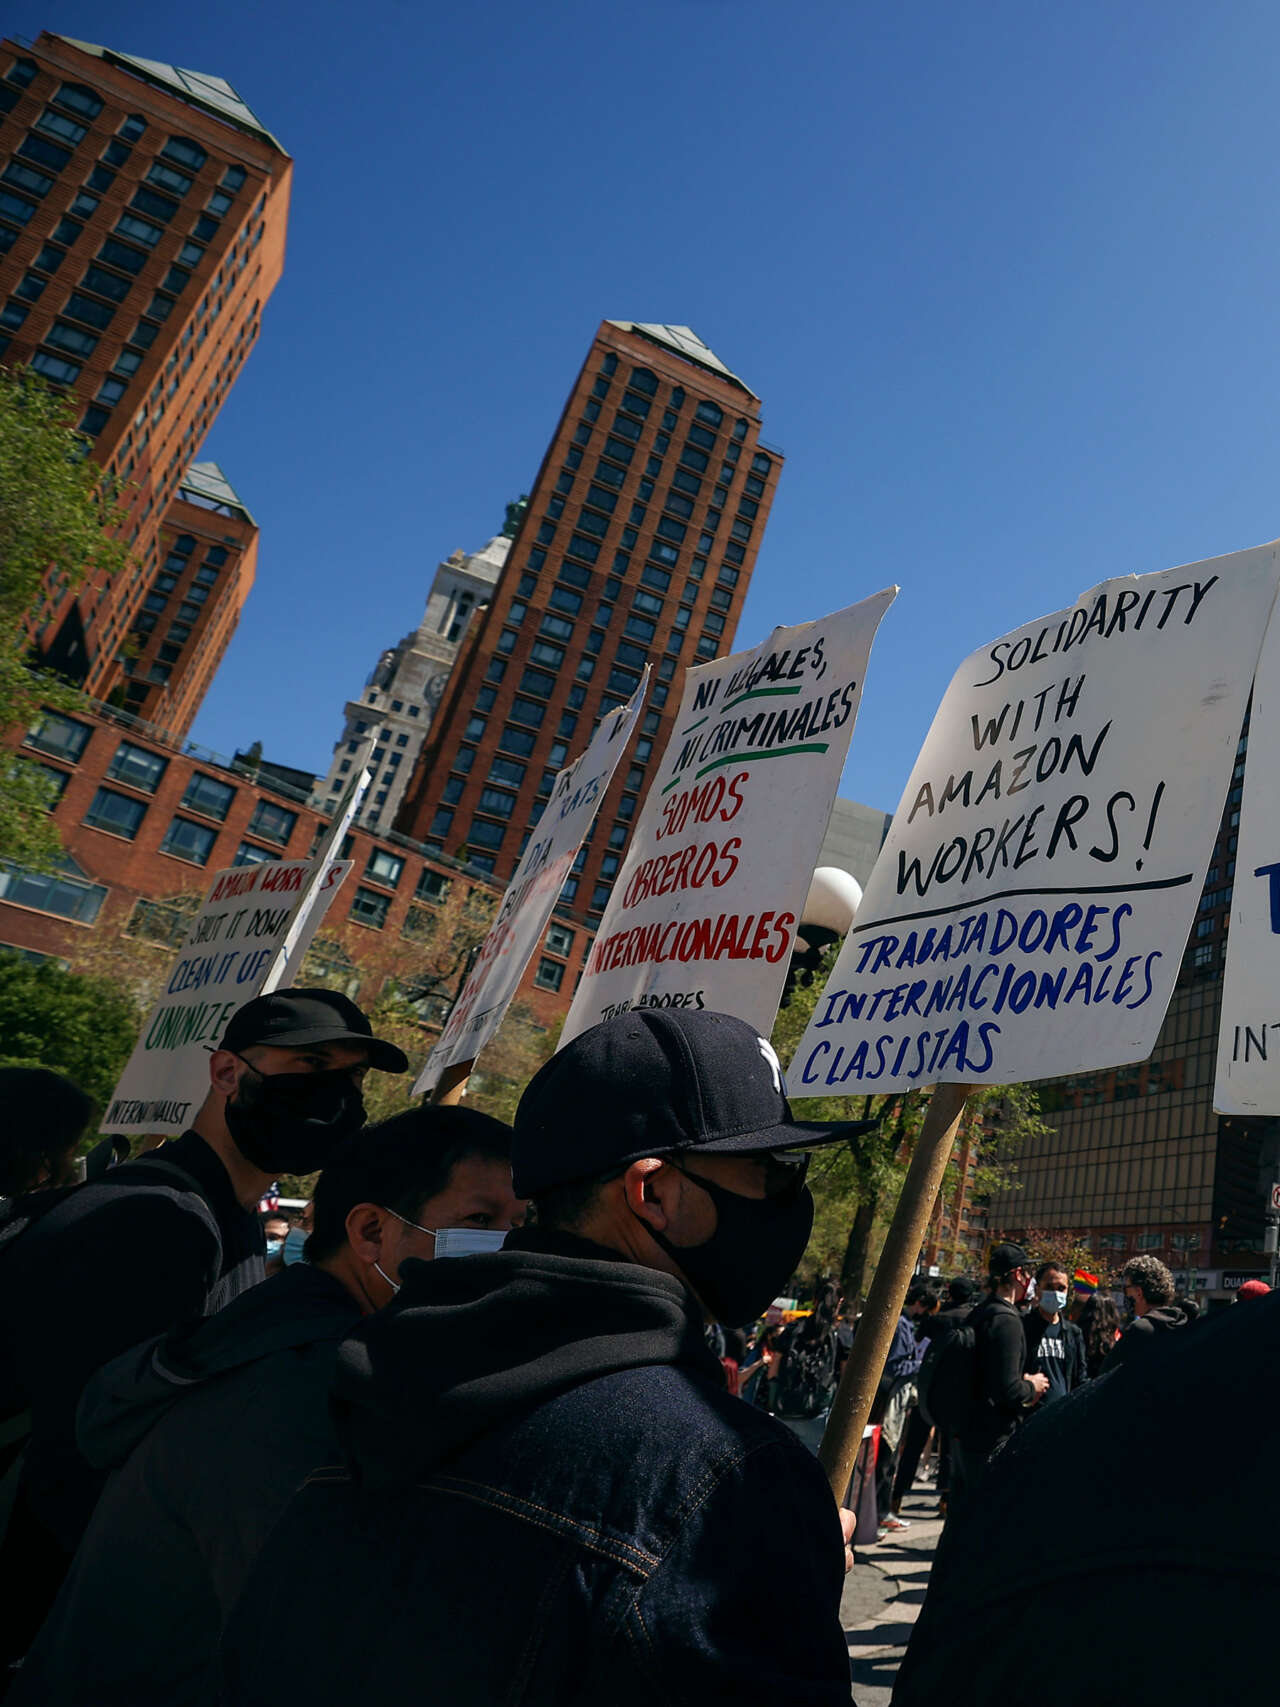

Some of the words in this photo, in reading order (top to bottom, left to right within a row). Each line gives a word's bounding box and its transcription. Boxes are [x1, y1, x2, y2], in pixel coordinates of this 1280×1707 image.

[973, 575, 1220, 688] SOLIDARITY
[692, 678, 717, 712] NI
[724, 637, 827, 699] ILLEGALES,
[672, 732, 698, 774] NI
[698, 681, 857, 763] CRIMINALES
[971, 673, 1086, 751] WITH
[655, 772, 749, 841] SOMOS
[907, 719, 1113, 824] AMAZON
[622, 836, 742, 910] OBREROS
[896, 781, 1165, 897] WORKERS!
[225, 908, 249, 940] IT
[585, 911, 796, 977] INTERNACIONALES
[856, 902, 1133, 975] TRABAJADORES
[167, 954, 217, 995] CLEAN
[214, 950, 240, 985] IT
[814, 950, 1163, 1028] INTERNACIONALES
[144, 1002, 236, 1051] UNIONIZE
[801, 1019, 1001, 1086] CLASISTAS
